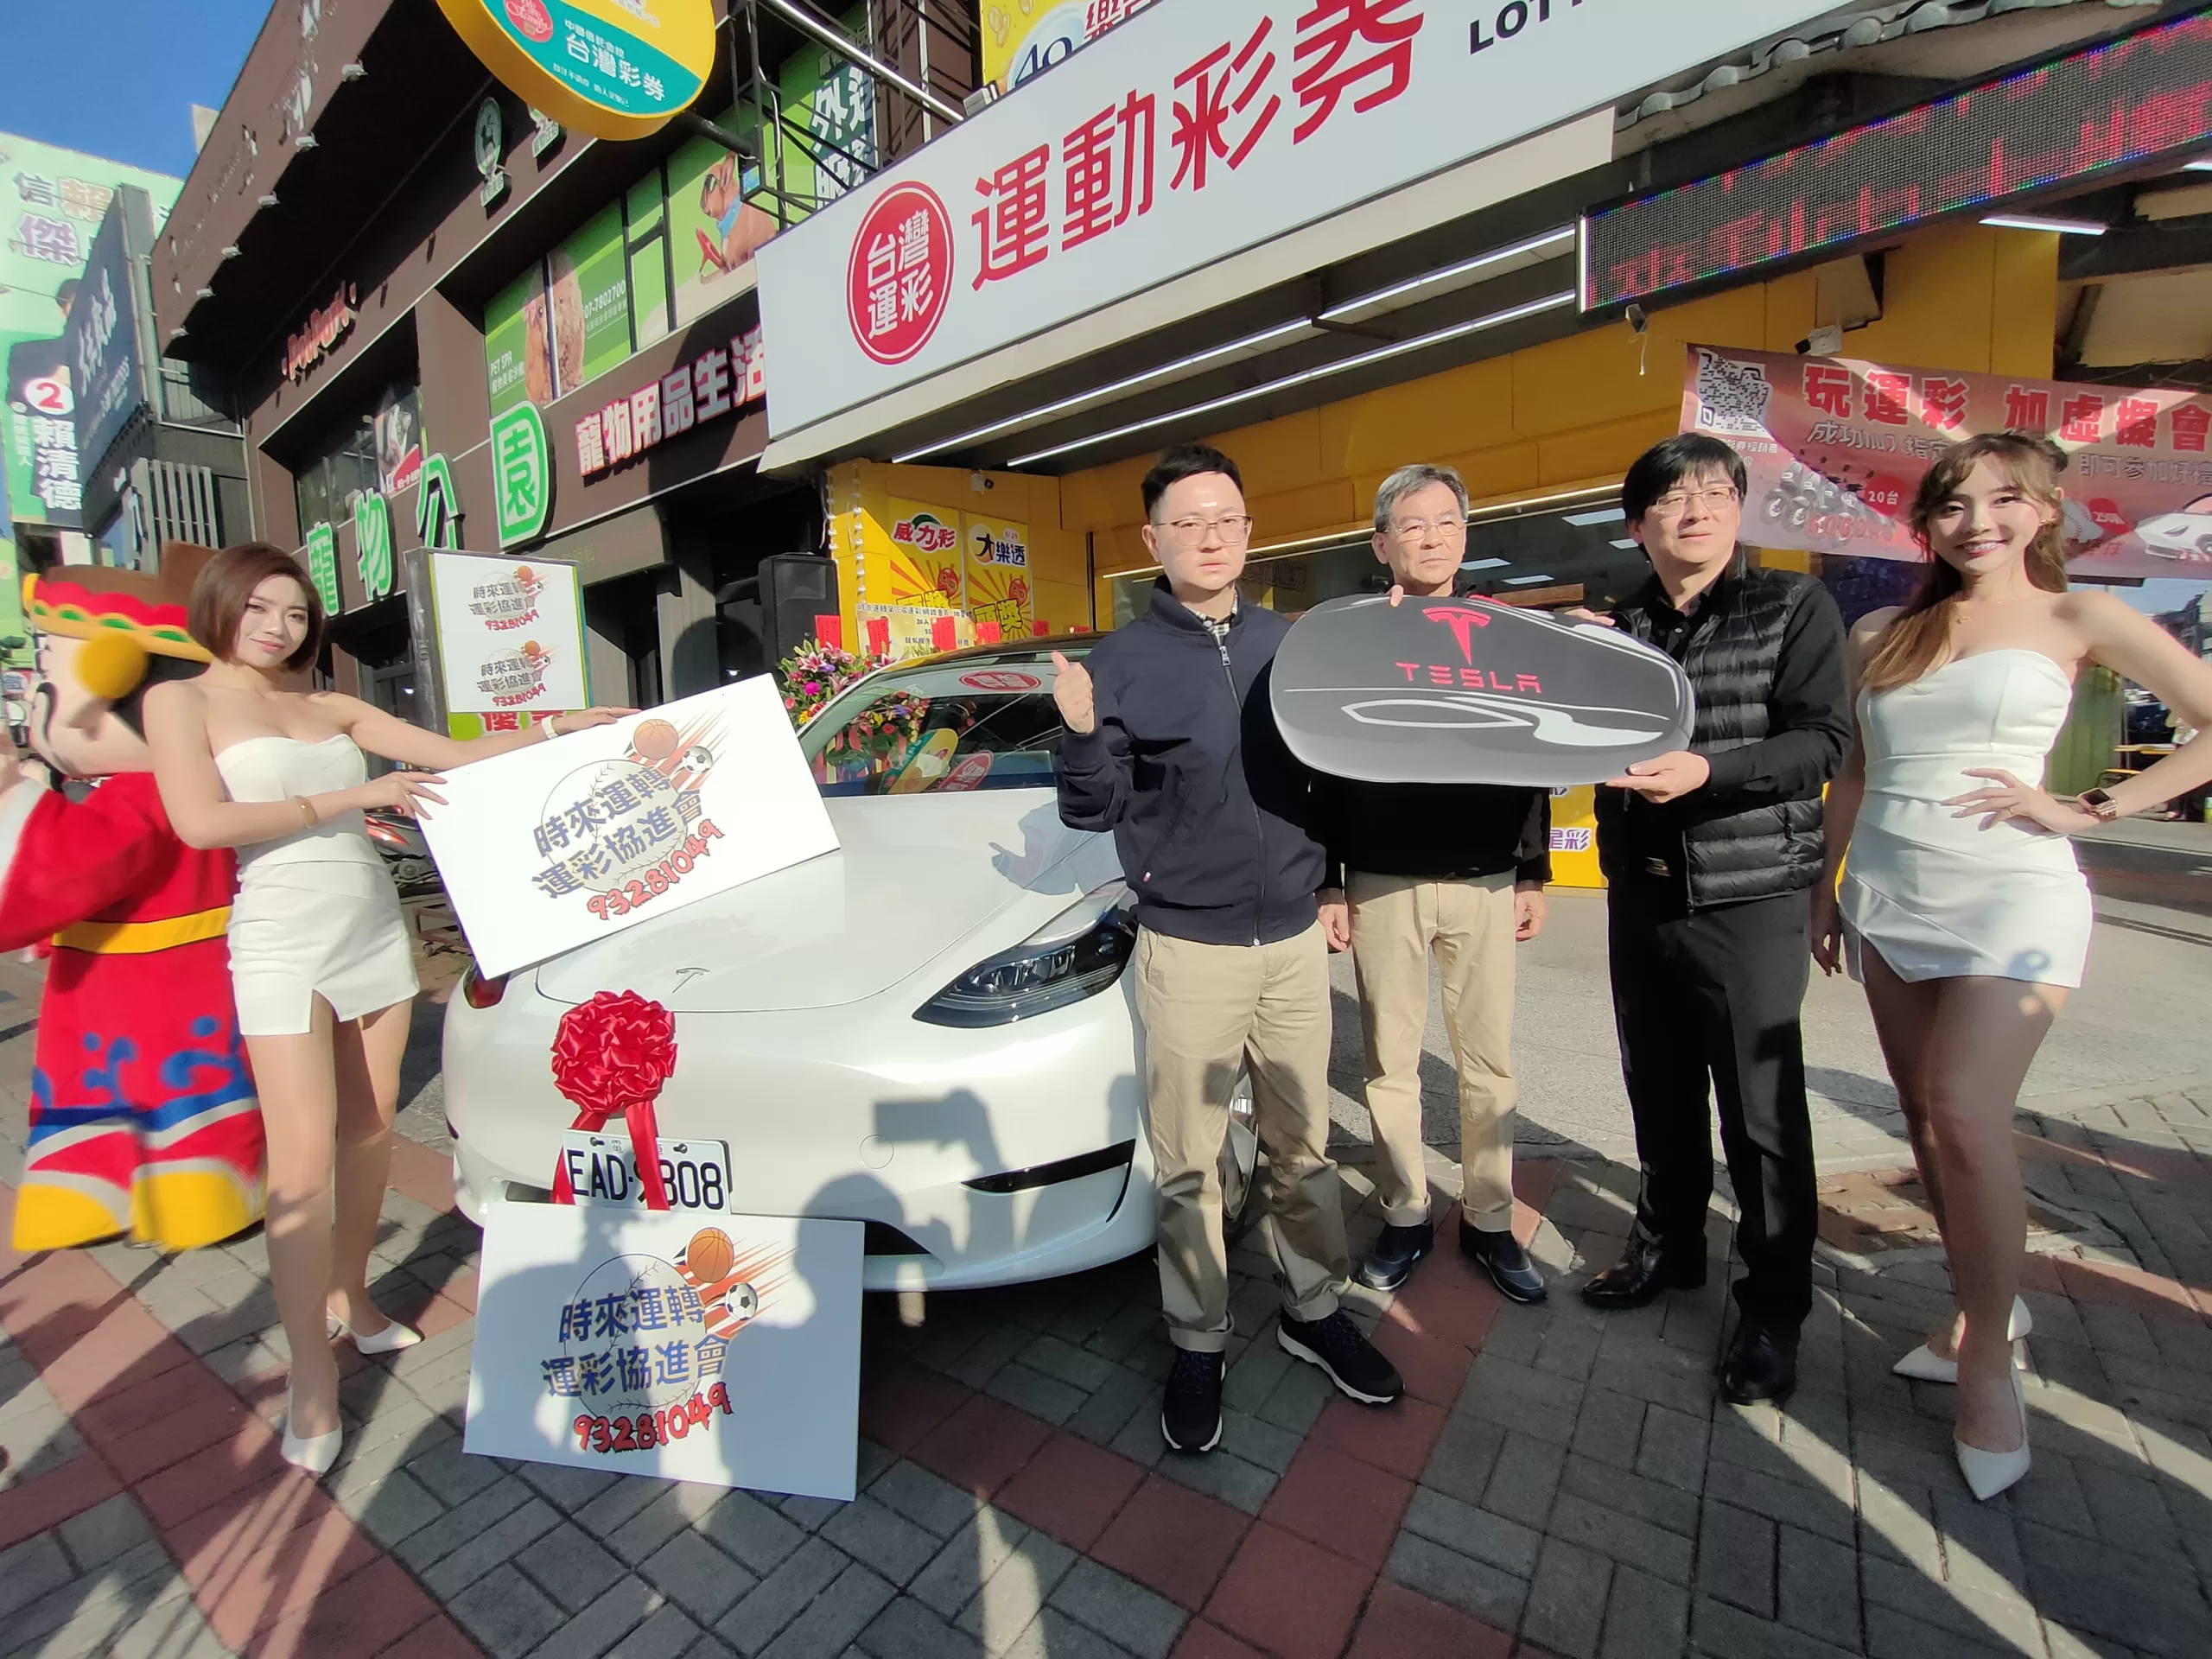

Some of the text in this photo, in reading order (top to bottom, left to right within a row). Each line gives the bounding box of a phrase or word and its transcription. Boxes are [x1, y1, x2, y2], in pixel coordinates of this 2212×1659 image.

[1469, 0, 1583, 55] LOT
[566, 33, 665, 102] 台灣彩券
[970, 0, 1424, 292] 運動彩券
[867, 208, 930, 289] 台灣
[583, 279, 626, 320] 07-7802700
[868, 261, 934, 340] 運彩
[36, 382, 64, 410] 2
[1803, 364, 1969, 432] 玩運彩
[32, 416, 83, 511] 賴清德
[1867, 489, 1899, 506] 20台
[893, 521, 956, 551] 威力彩
[975, 532, 1027, 567] 大樂透
[1395, 661, 1542, 694] TESLA
[531, 788, 705, 899] 運彩協進會
[532, 765, 673, 859] 時來運轉
[586, 818, 726, 921] 93281049
[558, 1283, 707, 1344] 時來運轉
[540, 1333, 731, 1398] 運彩協進會
[573, 1381, 734, 1453] 93281049
